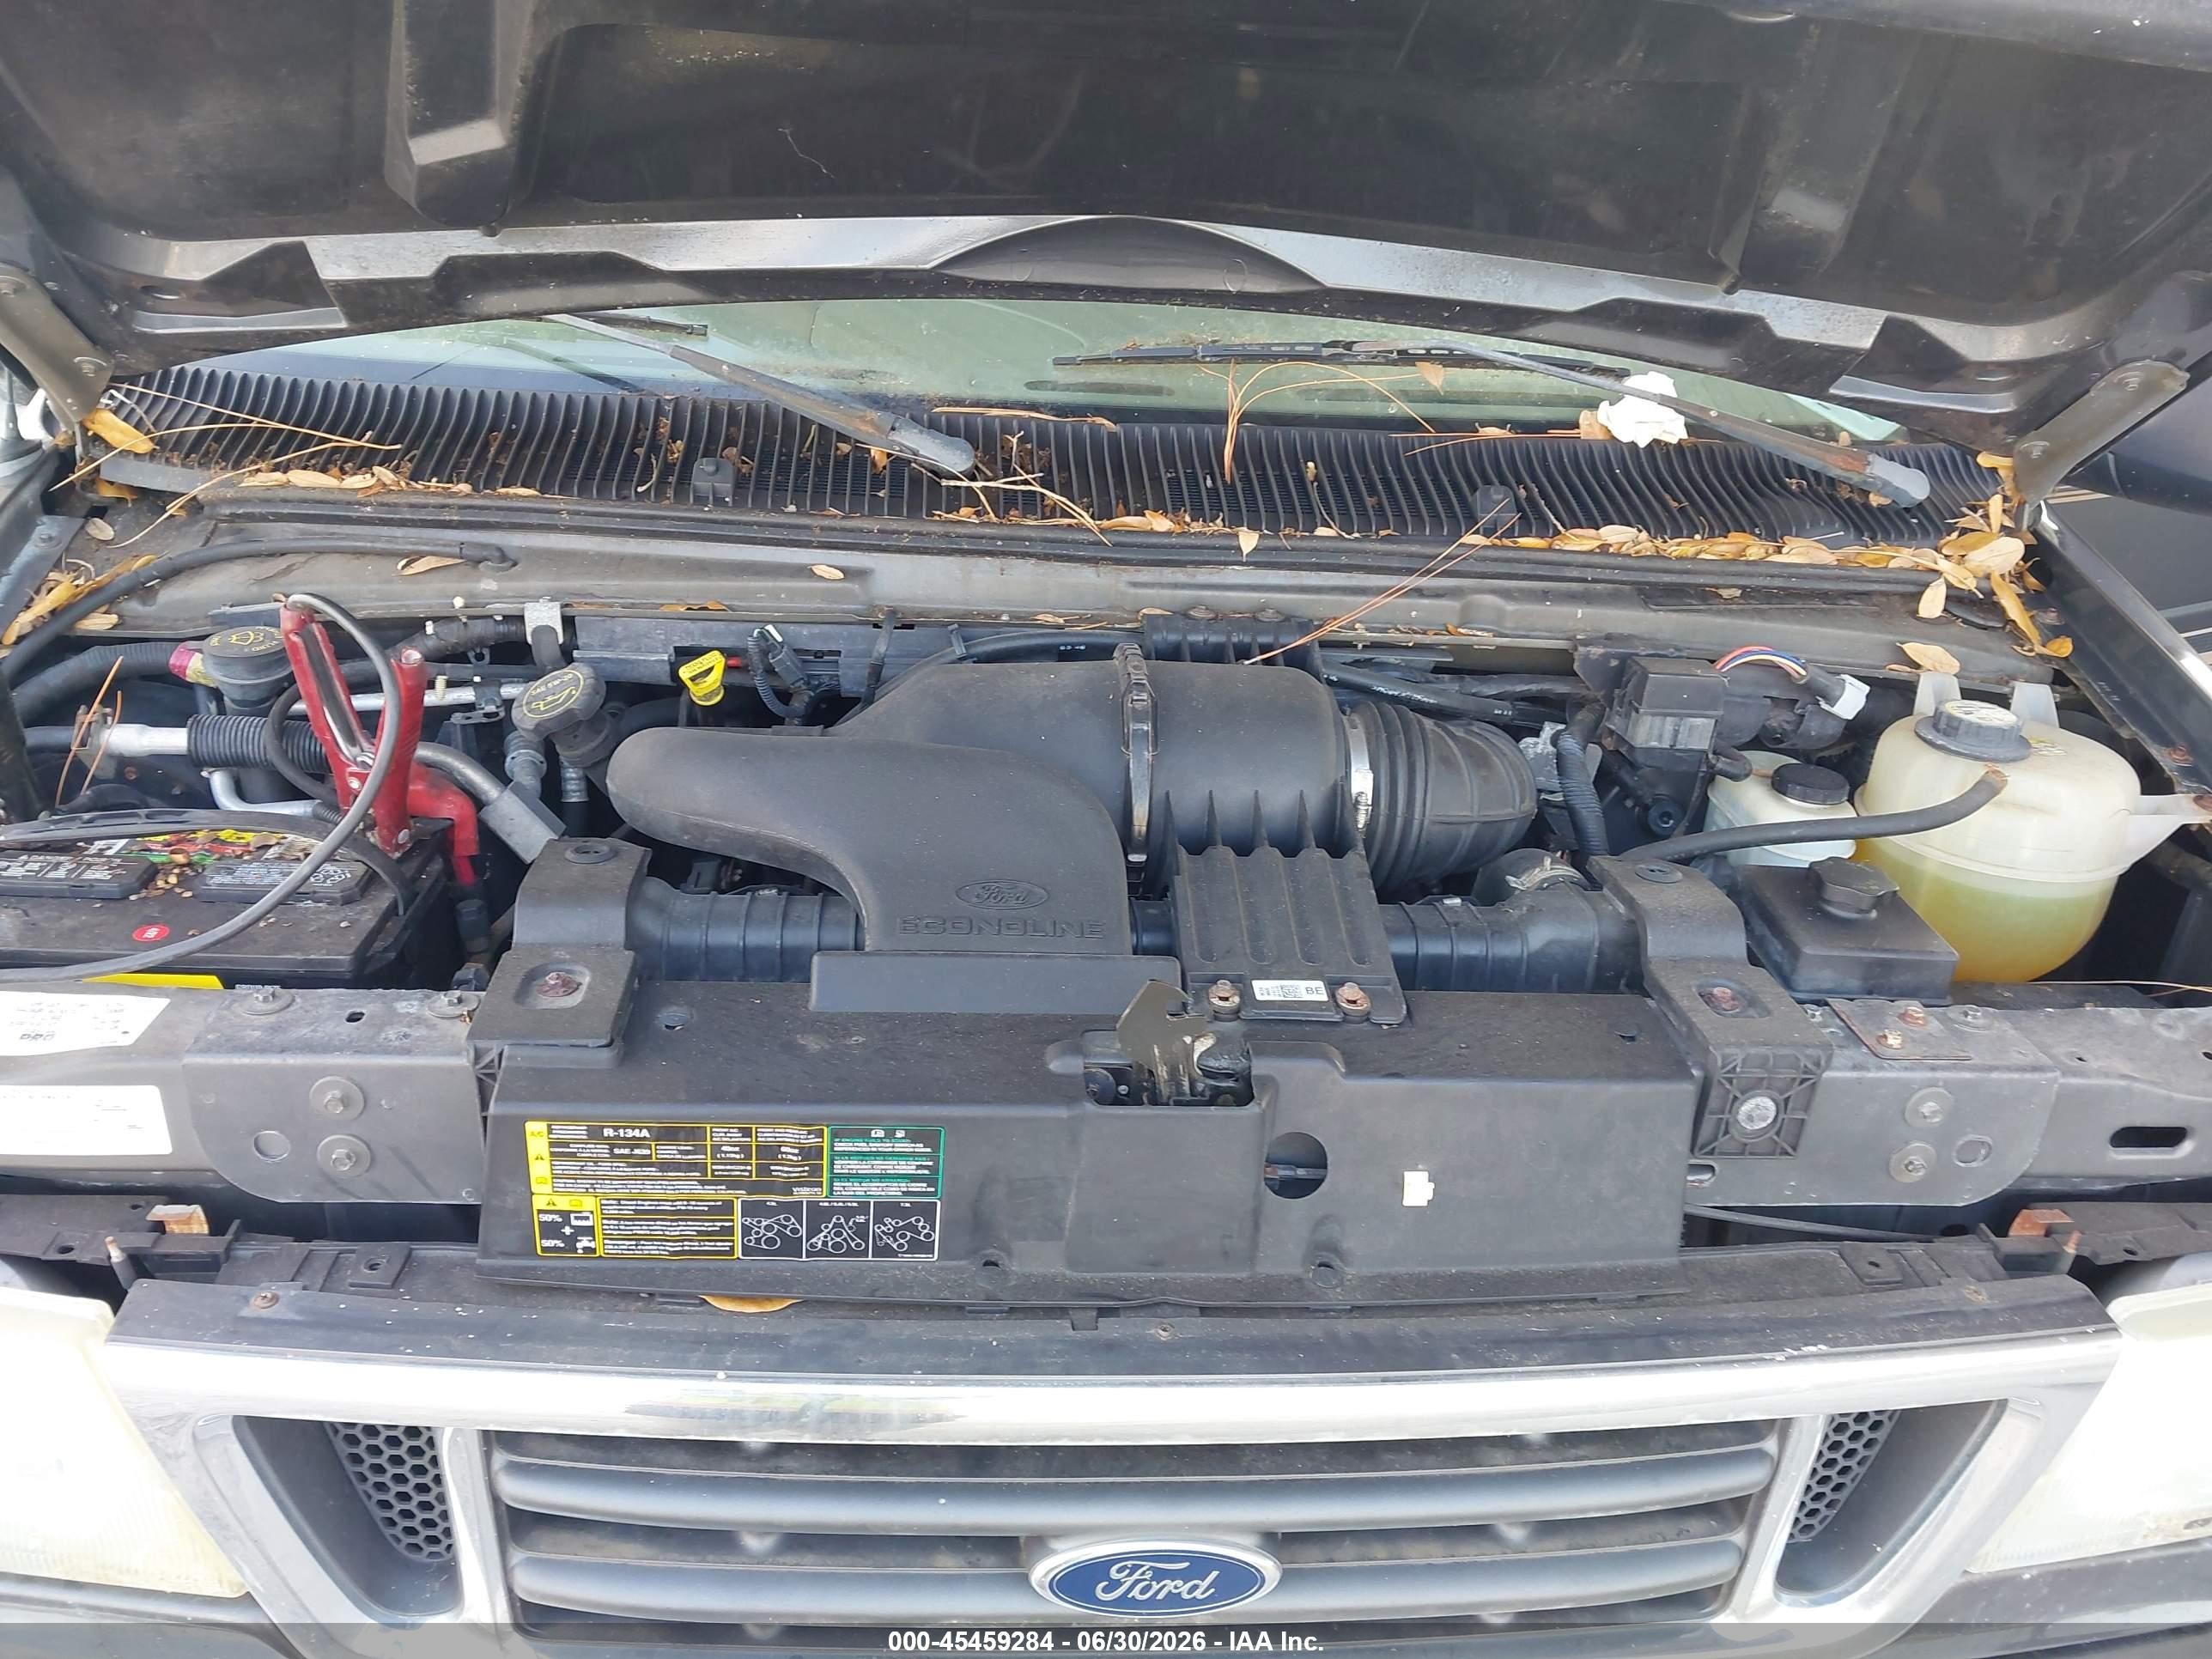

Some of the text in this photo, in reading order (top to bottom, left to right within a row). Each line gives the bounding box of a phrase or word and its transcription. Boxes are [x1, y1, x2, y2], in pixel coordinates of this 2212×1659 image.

[975, 882, 1030, 905] Ford
[899, 915, 1107, 939] ECONOLINE
[1305, 987, 1325, 995] BE
[603, 1127, 651, 1139] R-134A
[538, 1213, 563, 1223] 50%
[540, 1239, 565, 1248] 50%
[1095, 1560, 1220, 1601] Ford
